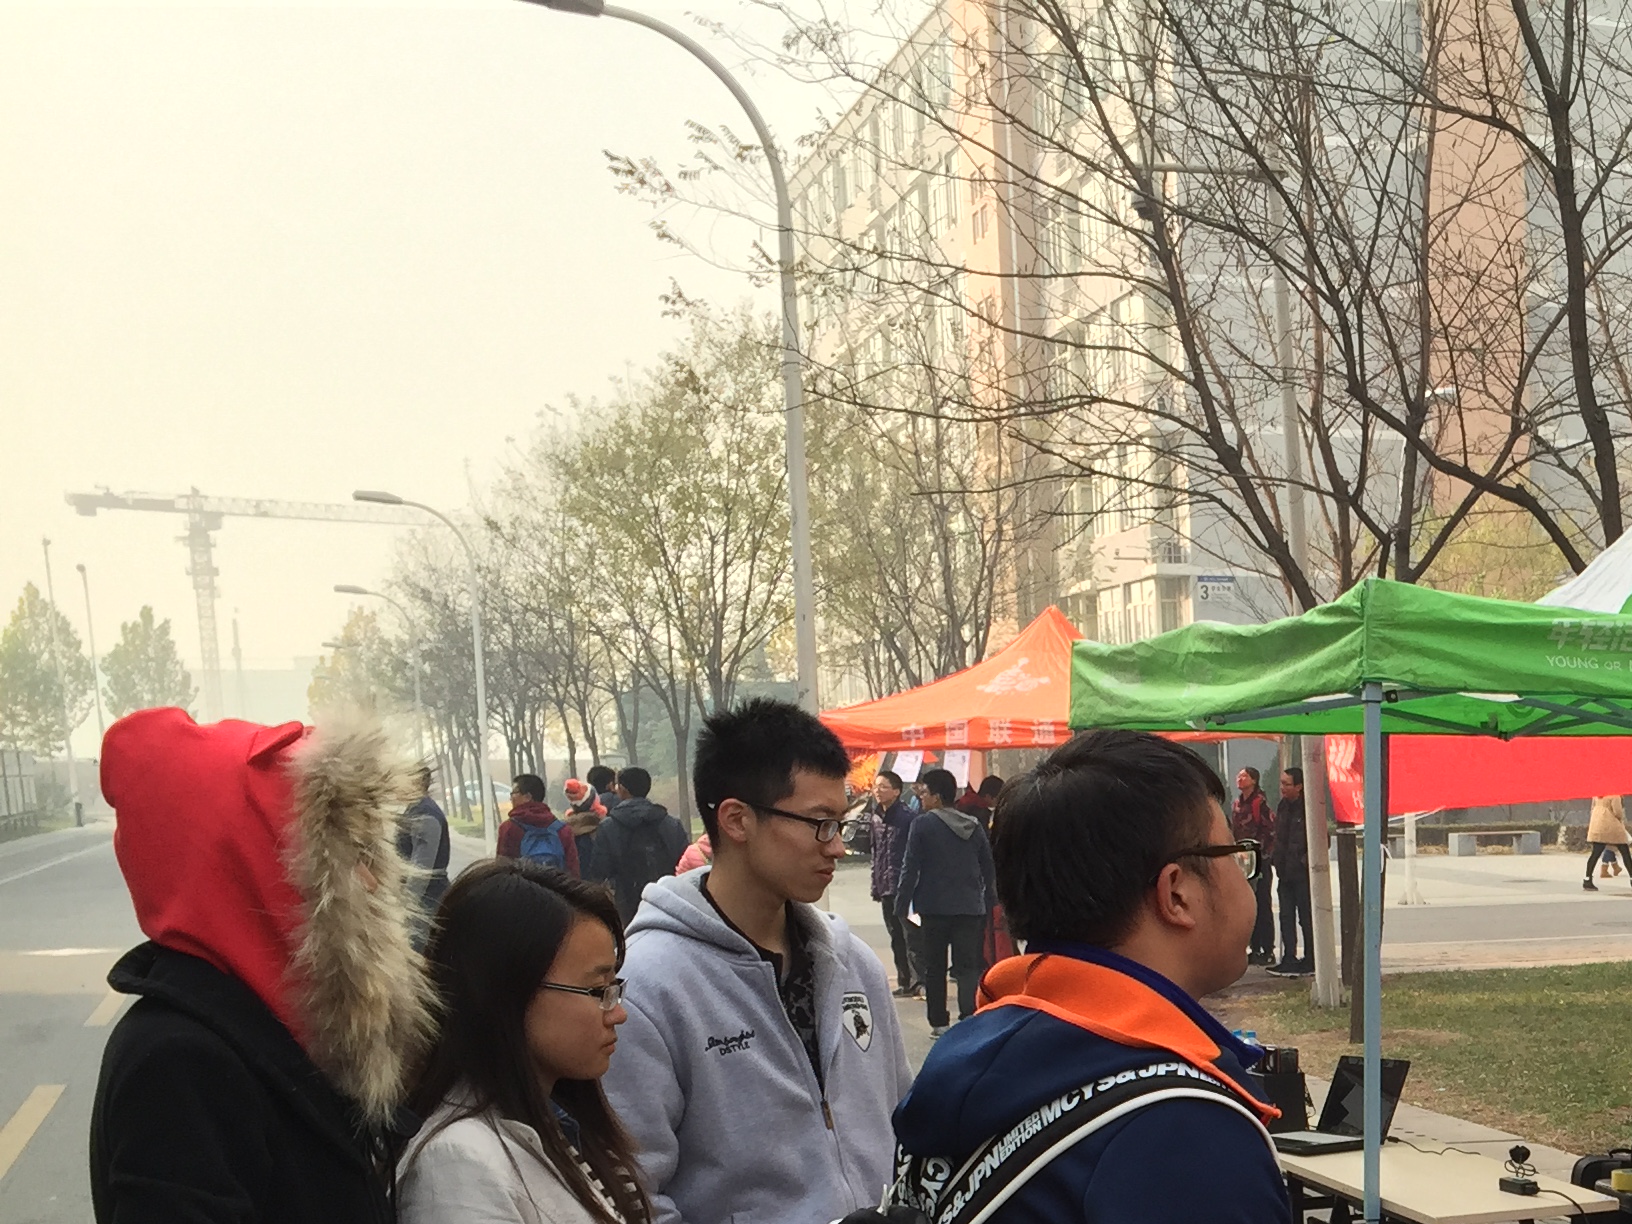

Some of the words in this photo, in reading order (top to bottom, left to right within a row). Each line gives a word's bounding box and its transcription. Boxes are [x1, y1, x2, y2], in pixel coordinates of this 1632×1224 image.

[1200, 584, 1209, 600] 3
[1545, 655, 1599, 669] YOUNG
[901, 718, 1056, 747] 中国联通
[999, 1109, 1041, 1148] LIMITED
[1000, 1122, 1043, 1164] EDITION
